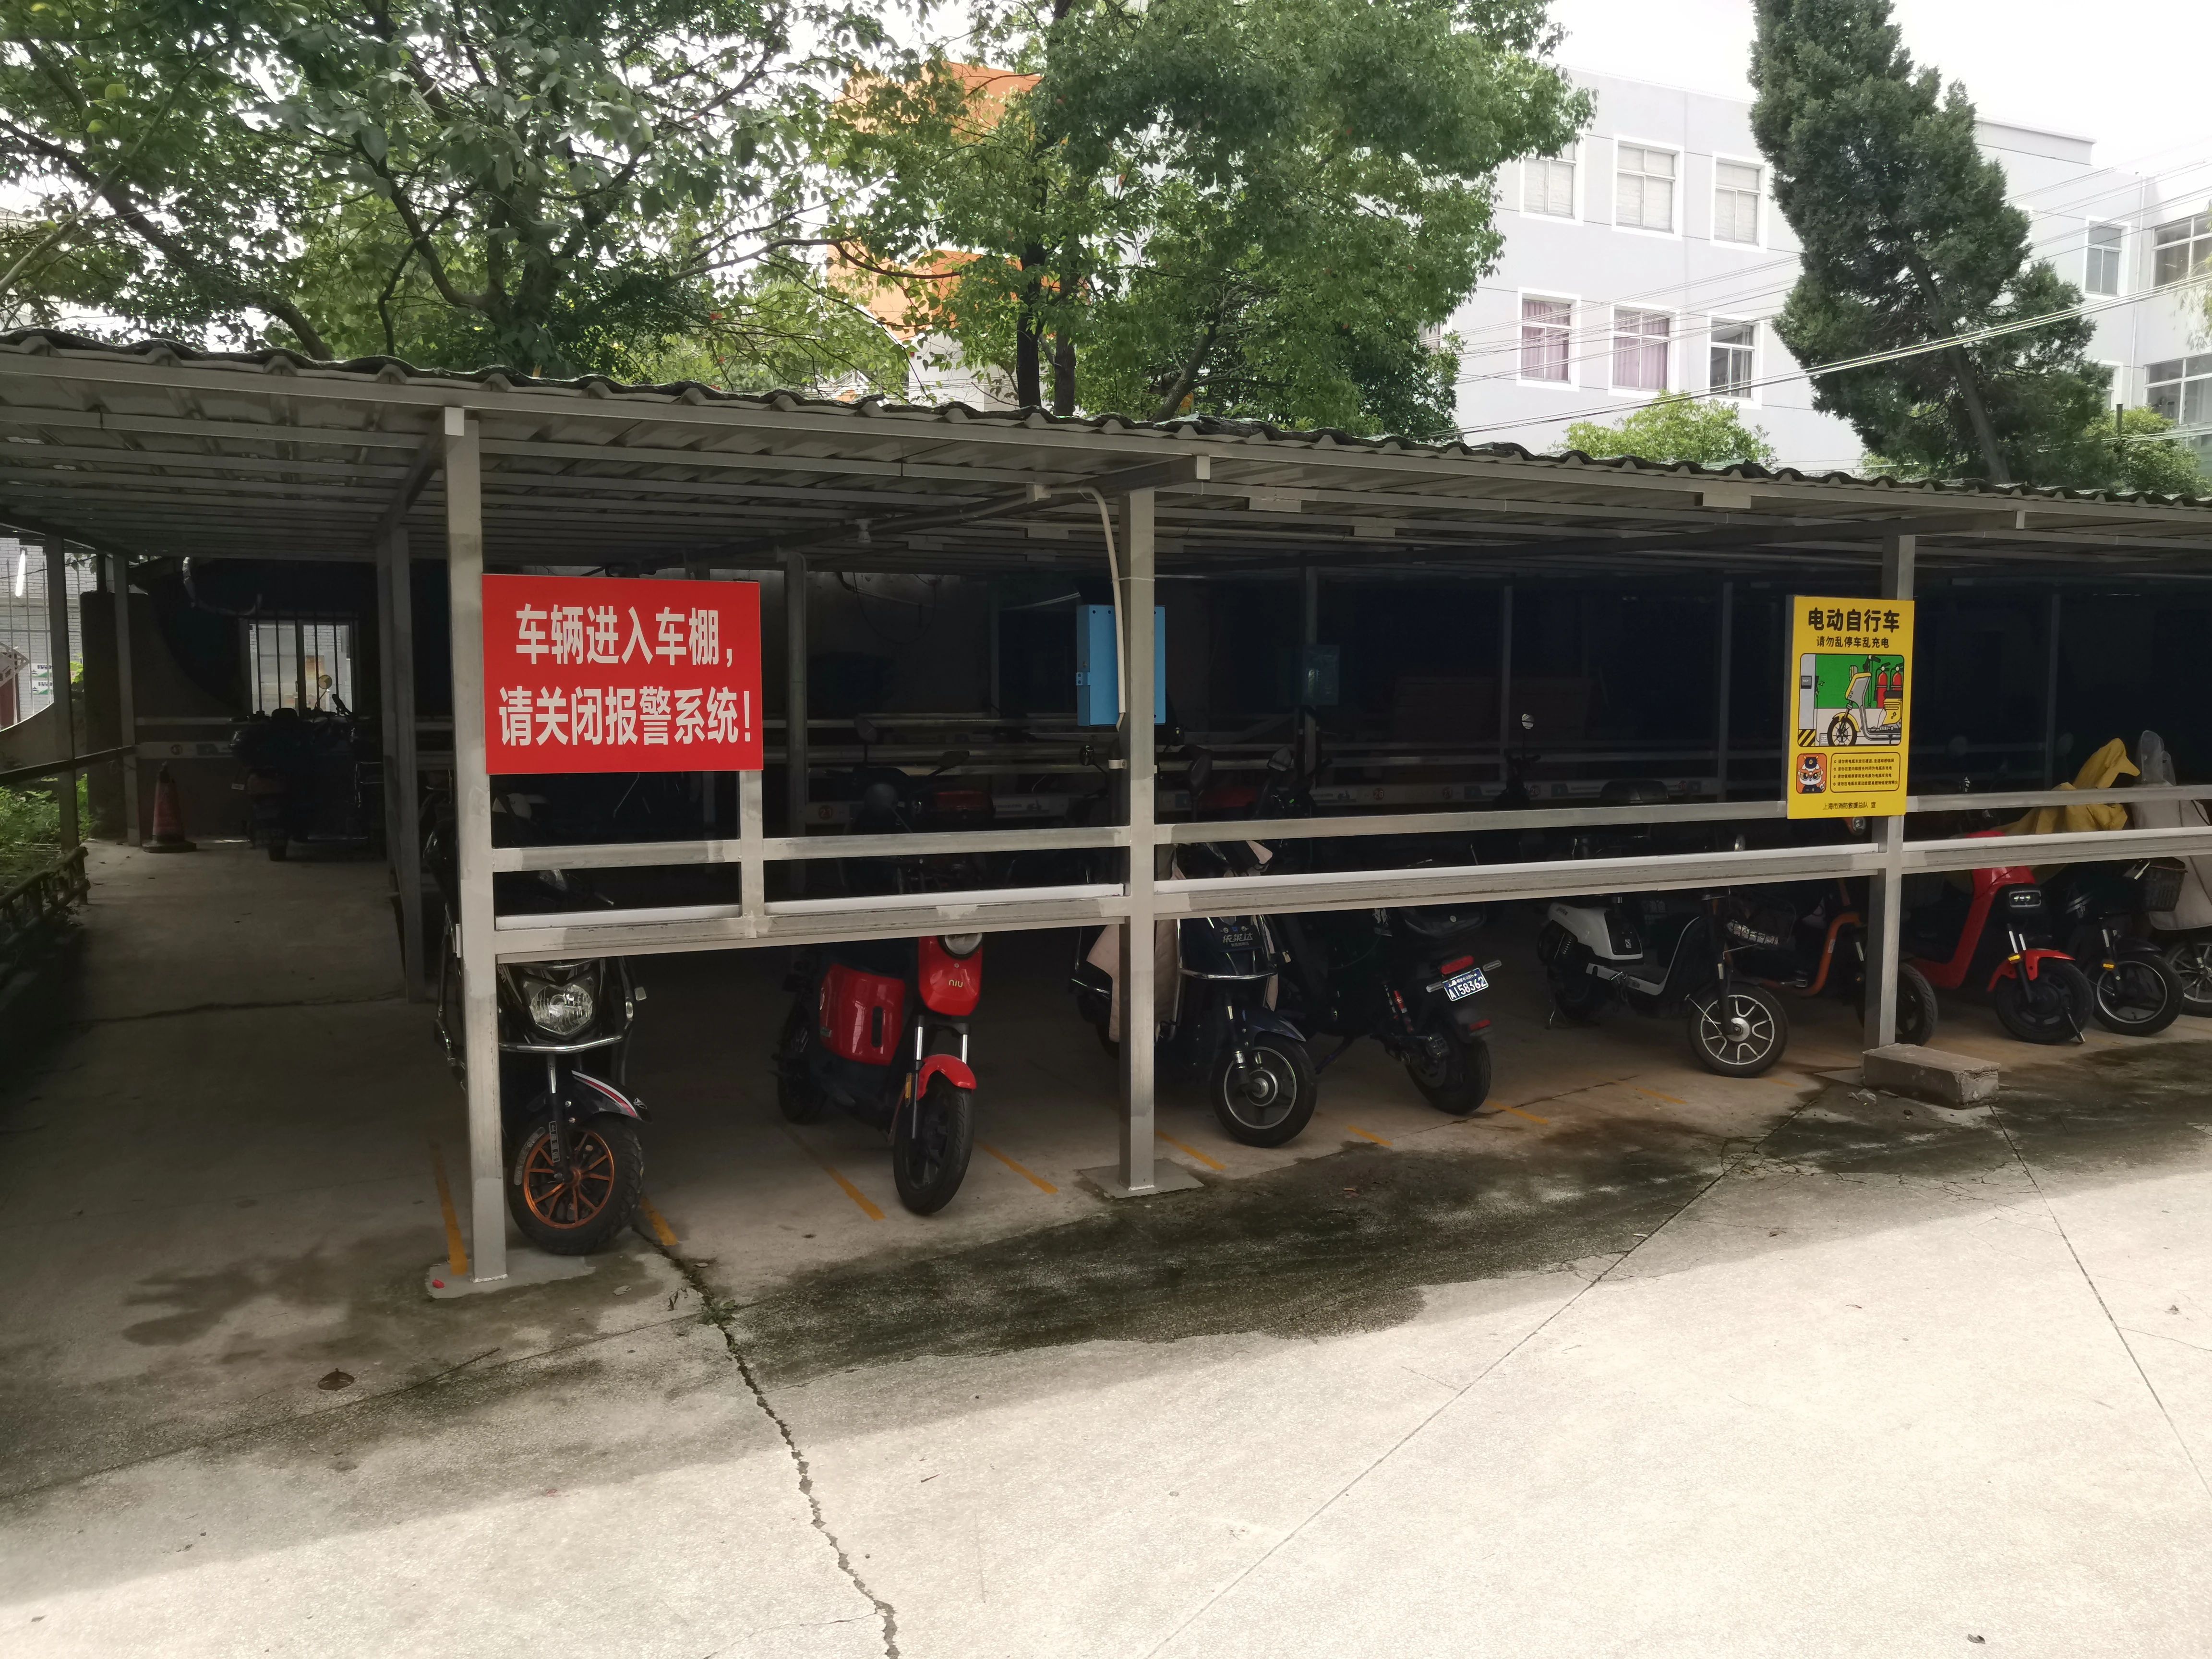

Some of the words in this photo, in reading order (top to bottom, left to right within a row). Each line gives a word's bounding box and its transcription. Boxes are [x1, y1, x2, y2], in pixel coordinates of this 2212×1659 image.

[516, 603, 733, 667] 车辆进入车棚，
[1808, 607, 1900, 633] 电动自行车
[1816, 636, 1889, 648] 请勿乱停车乱充电
[499, 685, 751, 746] 请关闭报警系统！
